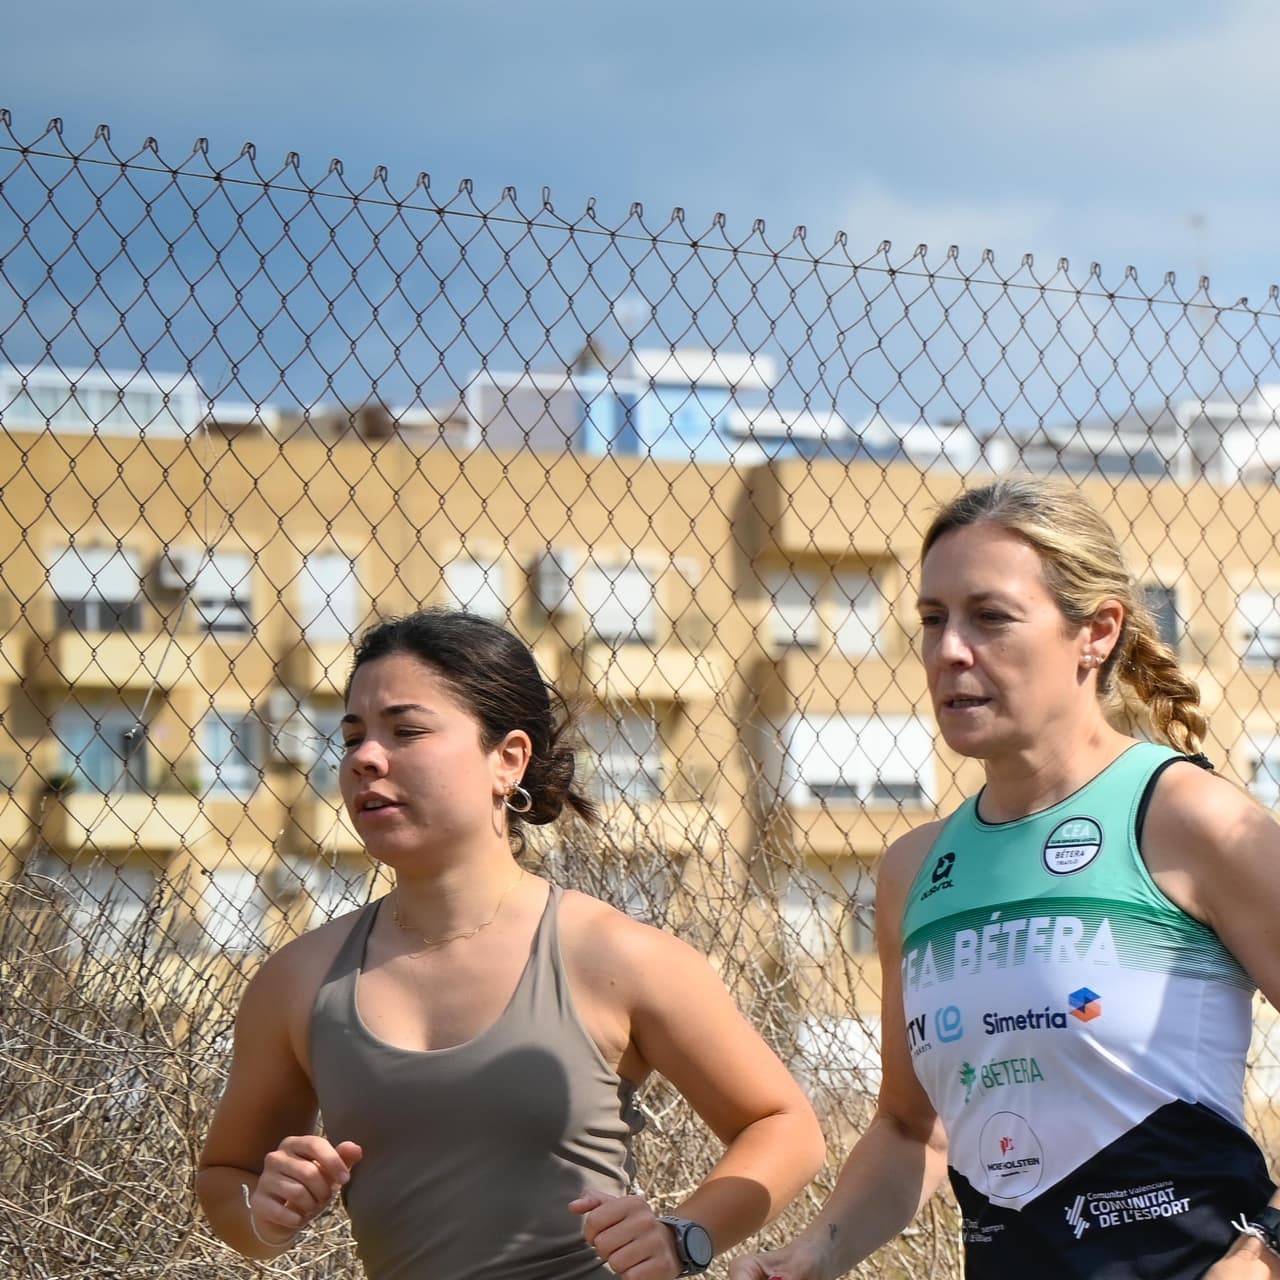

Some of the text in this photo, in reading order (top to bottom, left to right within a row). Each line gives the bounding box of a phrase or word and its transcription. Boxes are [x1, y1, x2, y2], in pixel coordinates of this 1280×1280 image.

[1062, 824, 1090, 837] CEA
[901, 911, 1121, 991] EA BÉTERA
[982, 1006, 1068, 1036] Simetría
[980, 1057, 1044, 1090] BÉTERA
[1086, 1190, 1129, 1200] Comunitat
[1089, 1187, 1175, 1215] COMUNITAT
[1098, 1198, 1190, 1228] DE L'ESPORT
